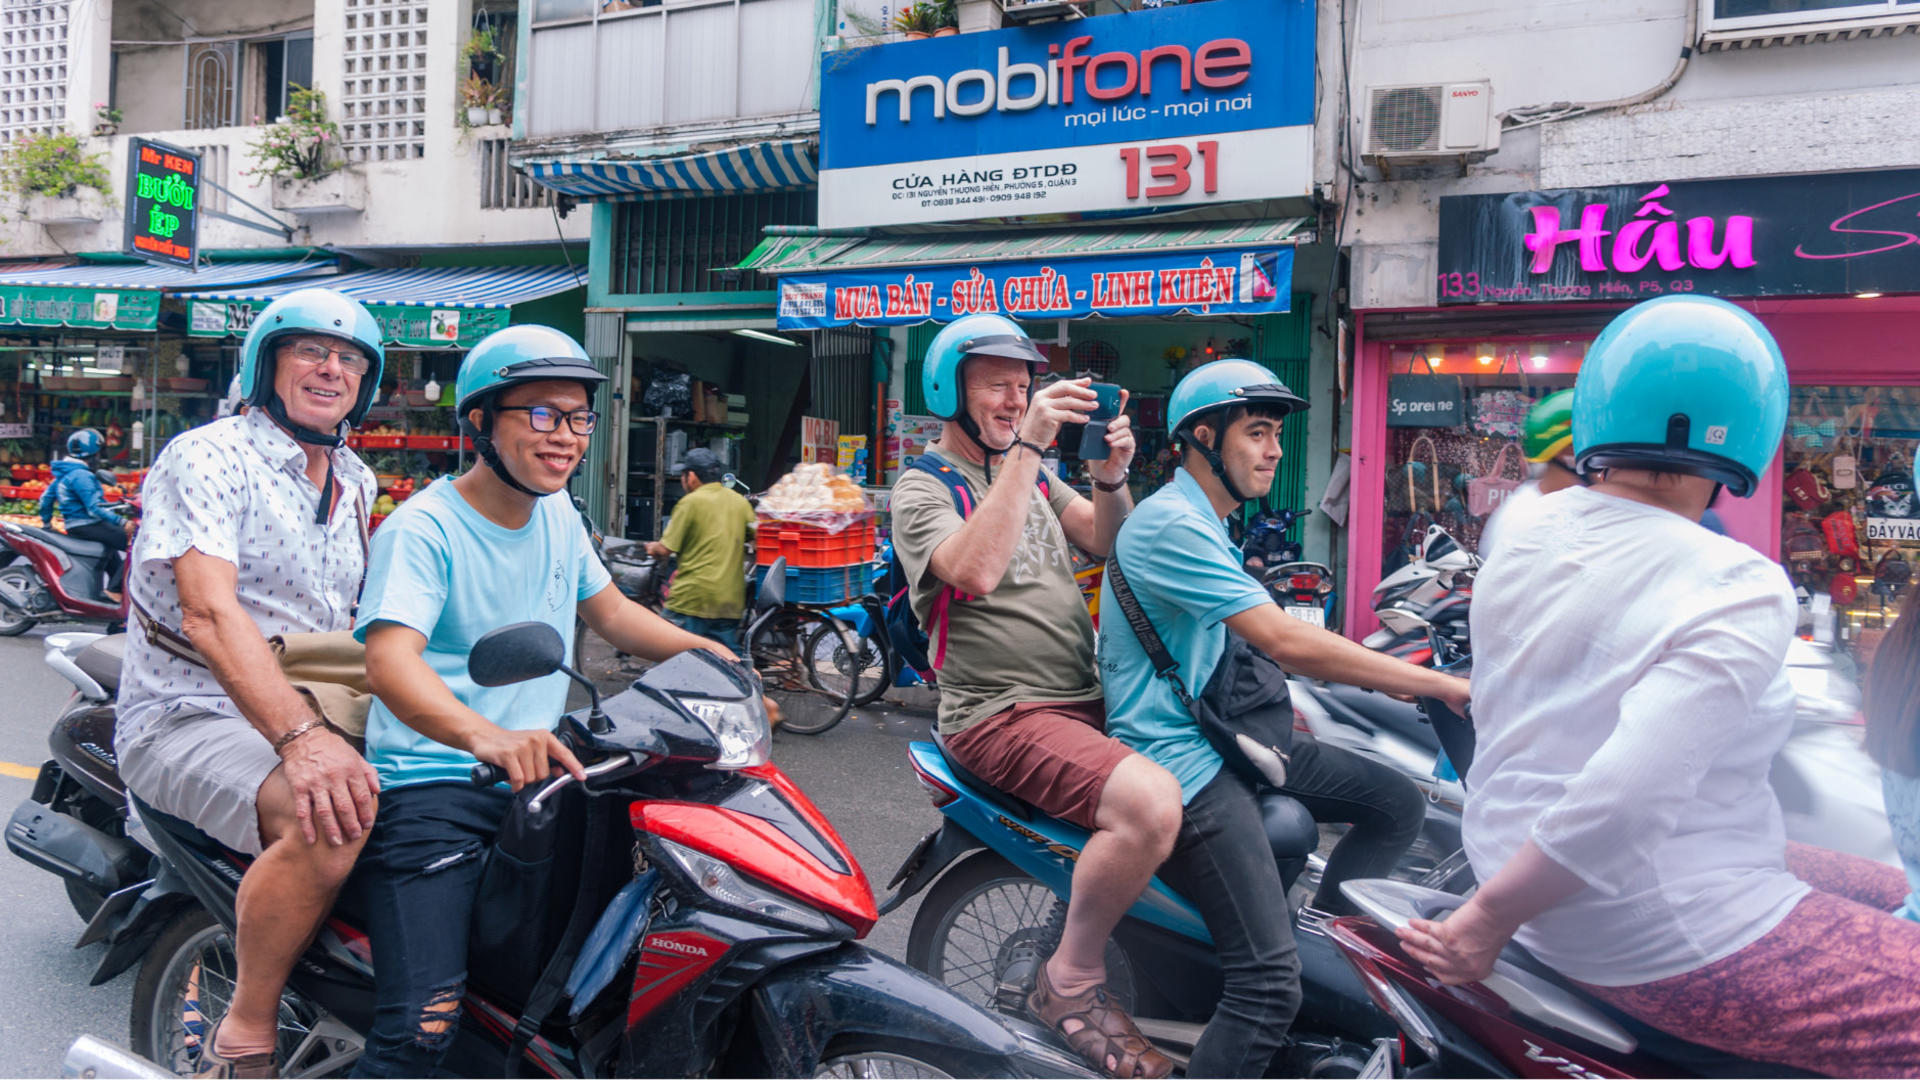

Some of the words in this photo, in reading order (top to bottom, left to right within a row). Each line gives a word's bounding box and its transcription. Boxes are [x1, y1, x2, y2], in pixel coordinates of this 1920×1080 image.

[865, 35, 1252, 125] mobifone
[1064, 108, 1107, 127] mọi
[1112, 105, 1146, 122] lúc
[1164, 98, 1209, 117] mọi
[1215, 93, 1252, 113] nơi
[892, 173, 934, 190] CỬA
[942, 169, 1003, 186] HÀNG
[1013, 163, 1077, 180] ĐTDĐ
[1120, 141, 1219, 199] 131
[1524, 184, 1758, 274] Hấu
[1794, 192, 1920, 259] S
[834, 285, 882, 320] MUA
[886, 273, 934, 317] BÁN
[951, 266, 999, 315] SỬA
[1003, 266, 1072, 312] CHỮA
[1091, 270, 1154, 308] LINH
[1437, 272, 1481, 297] 133
[1670, 280, 1694, 292] Q3
[651, 937, 709, 956] HONDA
